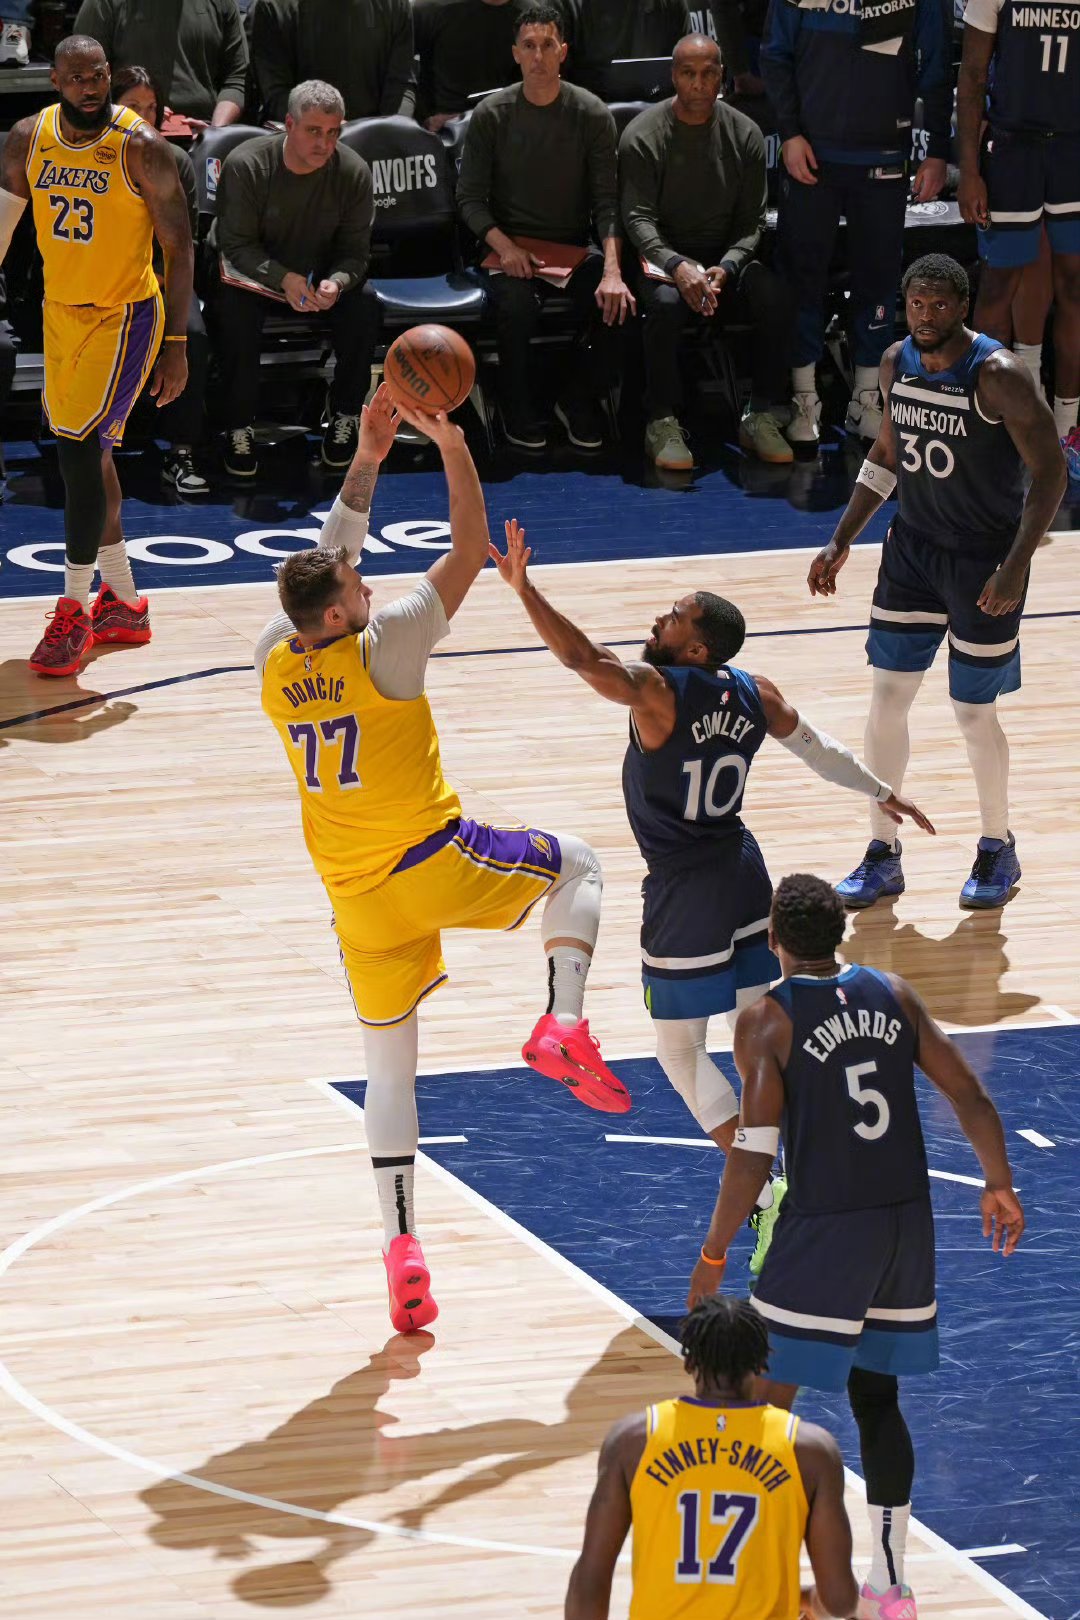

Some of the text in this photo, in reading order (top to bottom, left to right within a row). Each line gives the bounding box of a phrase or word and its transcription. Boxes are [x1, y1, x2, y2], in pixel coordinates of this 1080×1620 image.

[1039, 34, 1069, 74] 11
[34, 159, 110, 194] LAKERS
[49, 194, 95, 245] 23
[890, 400, 967, 437] MINNESOTA
[862, 467, 875, 480] 30
[900, 431, 955, 479] 30
[281, 672, 345, 709] DONČIĆ
[691, 711, 755, 744] CONLEY
[286, 712, 363, 794] 77
[682, 754, 747, 821] 10
[802, 1009, 902, 1063] EDWARDS
[845, 1060, 890, 1140] 5
[737, 1128, 747, 1143] 5
[645, 1438, 791, 1493] FINNEY-SMITH
[674, 1489, 761, 1585] 17
